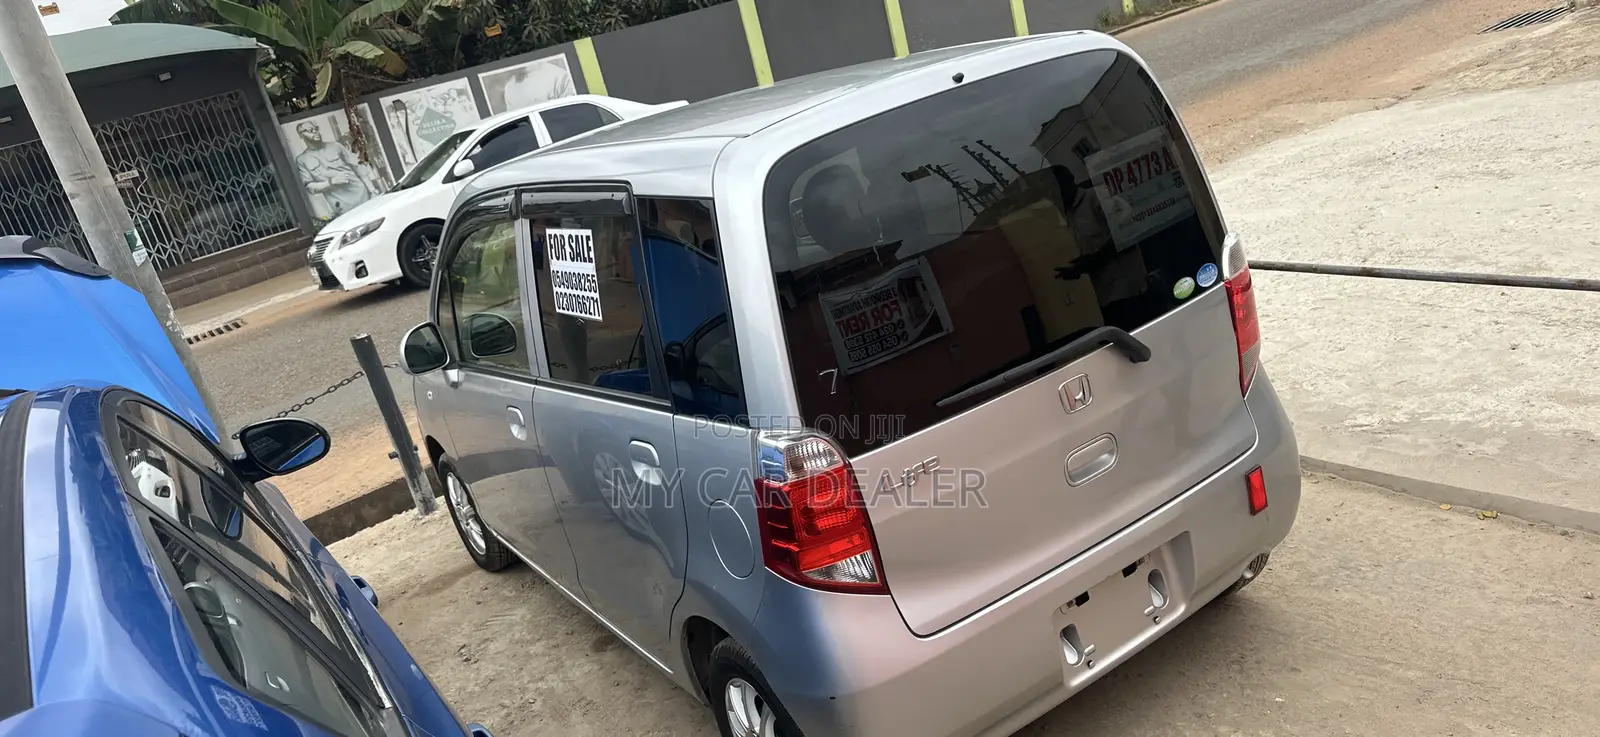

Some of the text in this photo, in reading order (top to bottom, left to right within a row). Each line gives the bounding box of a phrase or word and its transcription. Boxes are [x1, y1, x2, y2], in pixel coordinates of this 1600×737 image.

[1103, 146, 1174, 198] DP 4773 A
[548, 233, 594, 264] FOR SALE
[551, 269, 598, 294] 0549038255
[555, 291, 601, 318] 0230766271
